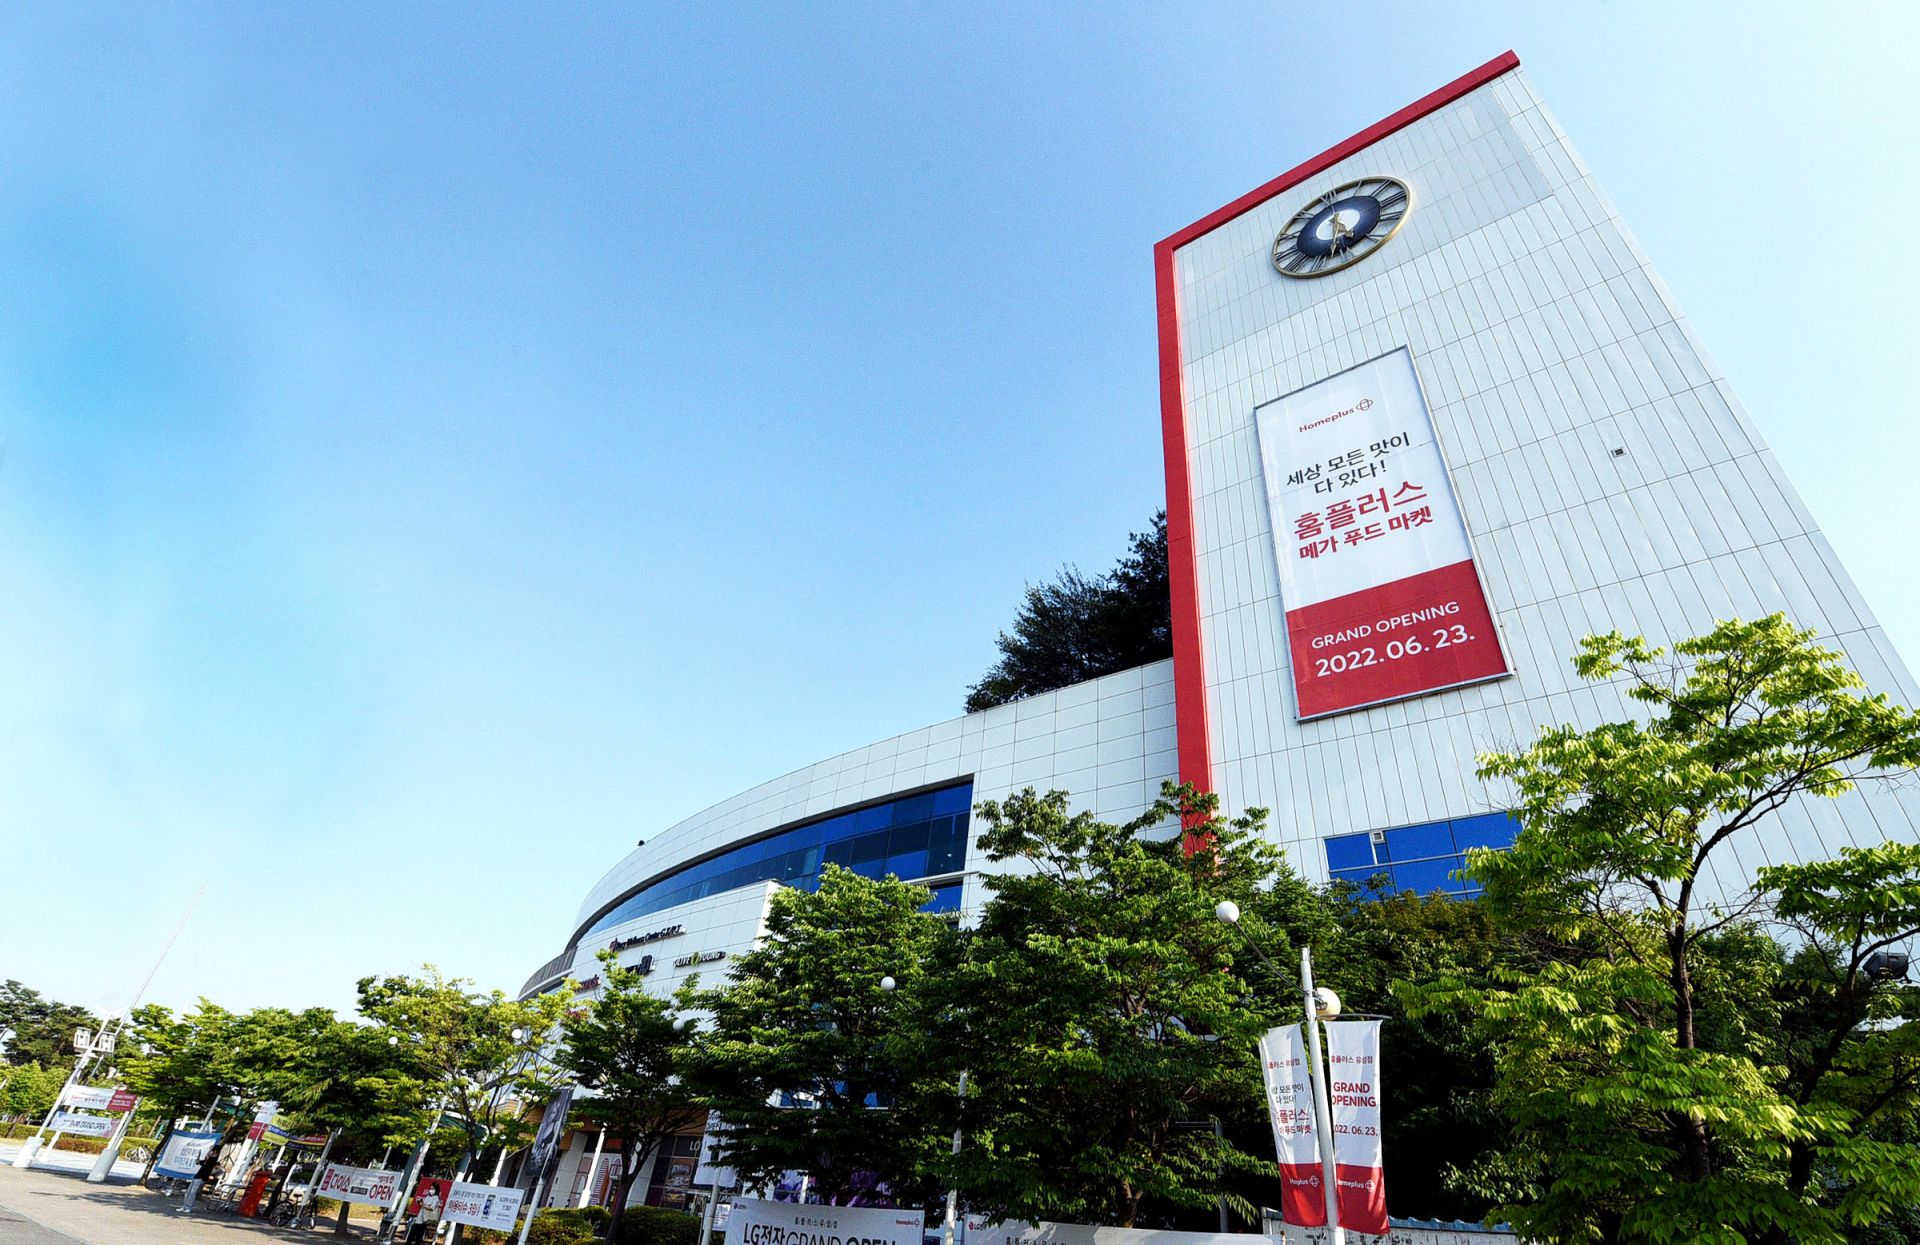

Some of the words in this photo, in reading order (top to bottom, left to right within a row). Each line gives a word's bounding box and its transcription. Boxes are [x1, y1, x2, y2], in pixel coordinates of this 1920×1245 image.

[1299, 406, 1354, 433] Homeplus
[1286, 463, 1322, 487] 세상
[1327, 450, 1366, 474] 모든
[1369, 432, 1410, 460] 맛이
[1314, 479, 1334, 494] 다
[1339, 461, 1387, 489] 있다!
[1294, 480, 1428, 541] 홈플러스
[1299, 536, 1338, 560] 메가
[1344, 524, 1386, 548] 푸드
[1388, 505, 1433, 534] 마켓
[1311, 624, 1372, 650] GRAND
[1376, 601, 1460, 634] OPENING
[1331, 1055, 1354, 1064] 홈플러스
[1356, 1056, 1373, 1064] 유성점
[1280, 1085, 1291, 1094] 모든
[1292, 1083, 1304, 1092] 맛이
[1334, 1082, 1370, 1094] GRAND
[1276, 1096, 1282, 1104] 다
[1331, 1095, 1376, 1107] OPENING
[1277, 1108, 1310, 1124] 플러스
[368, 1184, 394, 1200] OPEN
